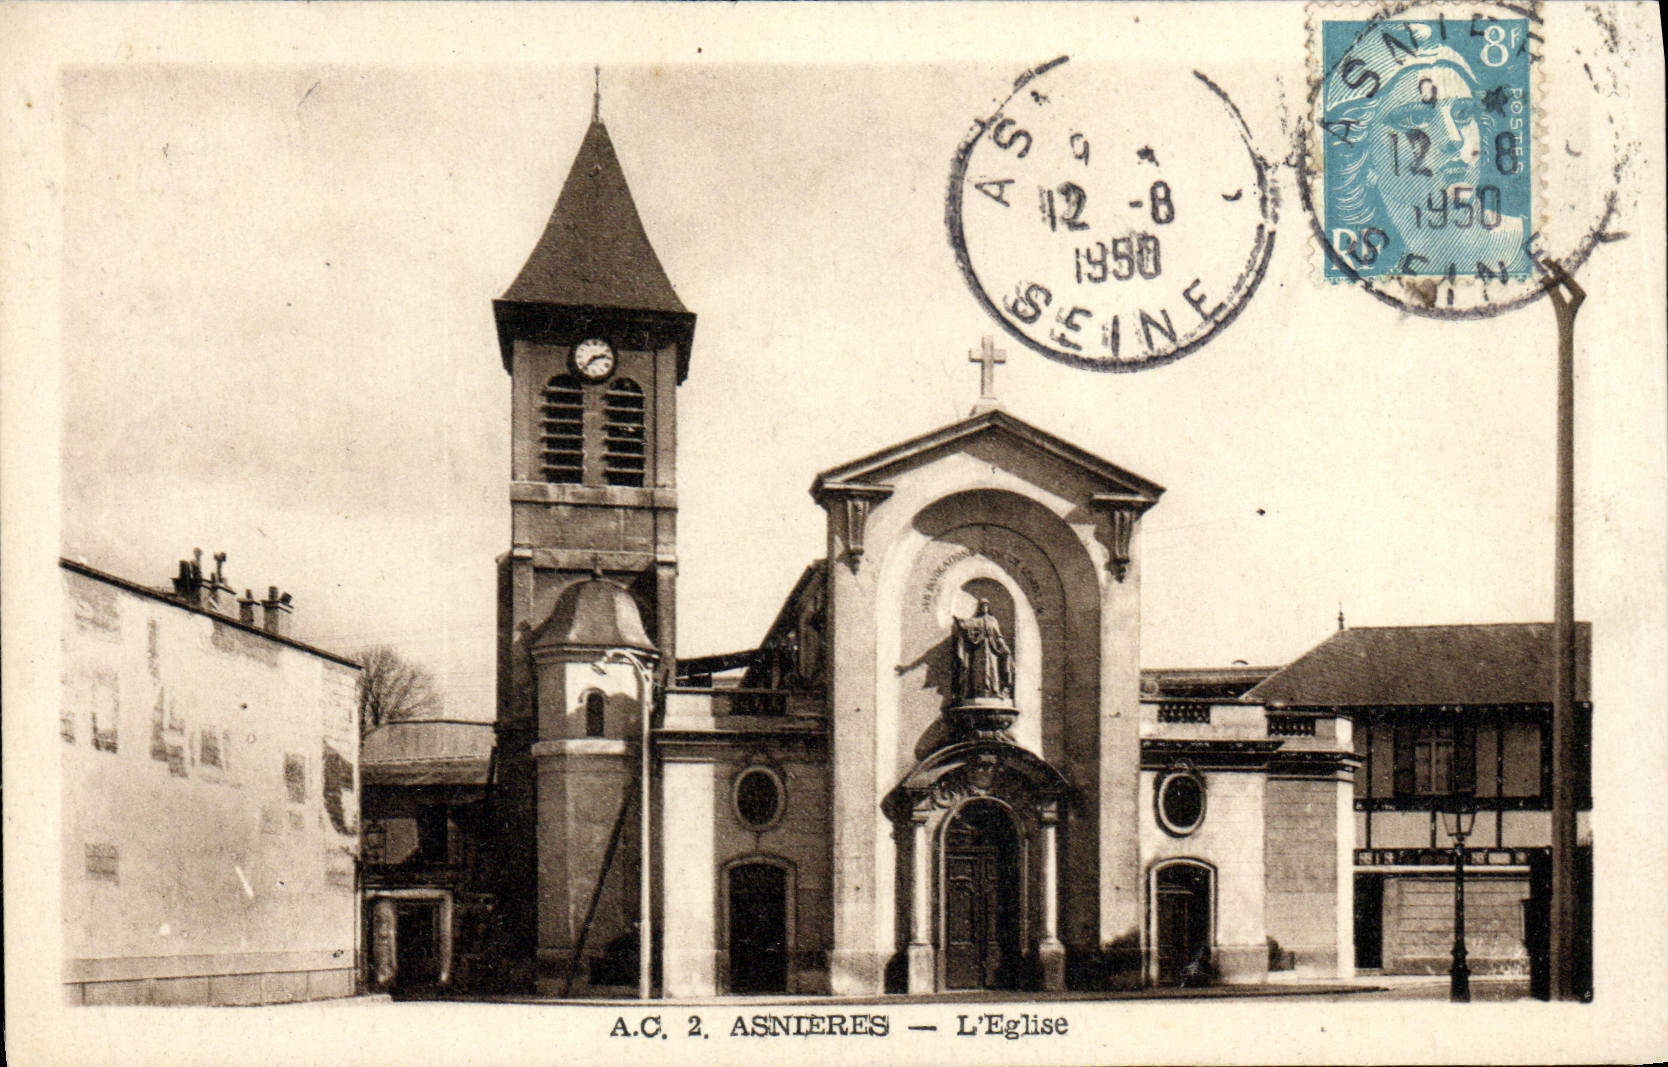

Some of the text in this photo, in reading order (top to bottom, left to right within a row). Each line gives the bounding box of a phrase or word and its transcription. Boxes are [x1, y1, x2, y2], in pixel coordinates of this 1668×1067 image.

[1389, 128, 1433, 177] 12
[1510, 87, 1524, 174] POSTES
[1040, 181, 1091, 232] 12
[1414, 184, 1502, 231] 1950
[1074, 232, 1162, 284] 1950
[1002, 279, 1227, 357] SEINE
[610, 1015, 668, 1040] A.C.
[687, 1015, 710, 1040] 2.
[956, 1013, 1070, 1041] L'Eglise
